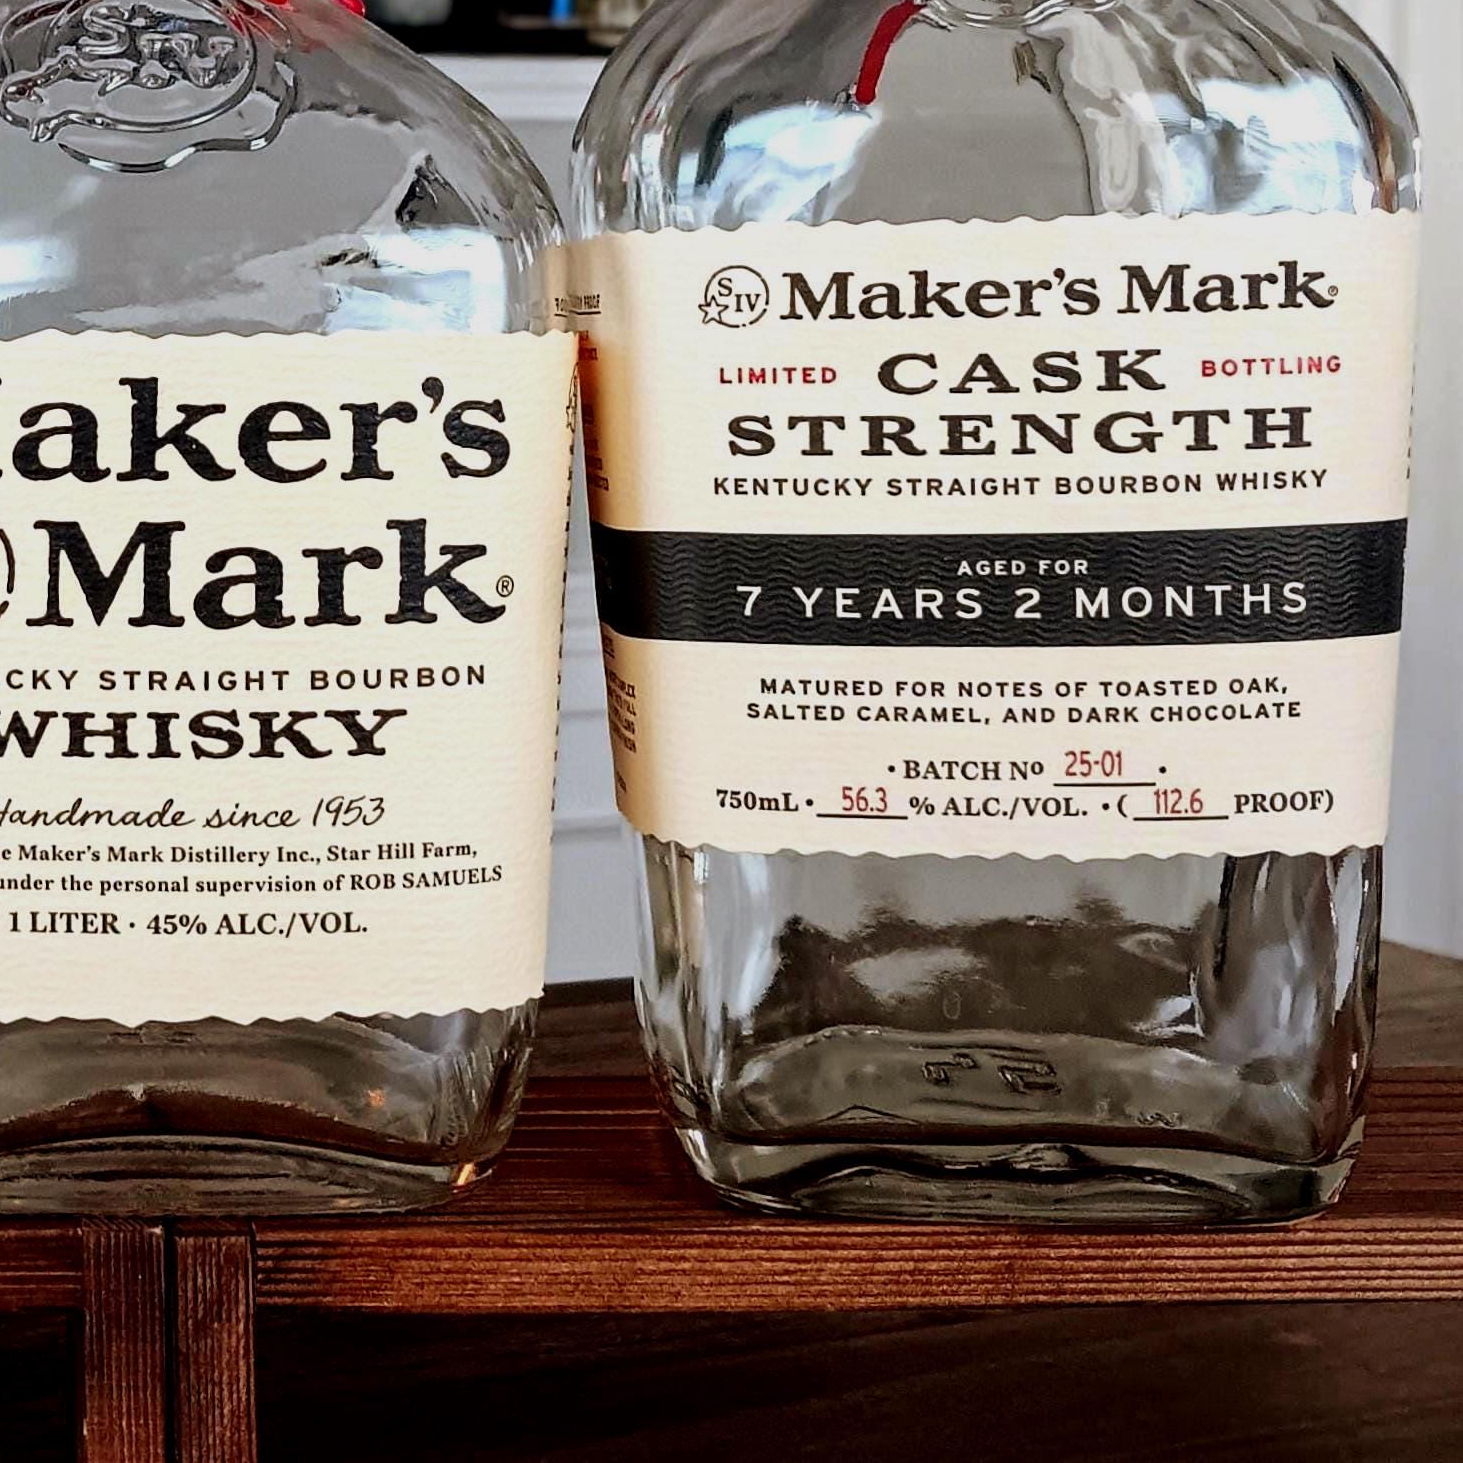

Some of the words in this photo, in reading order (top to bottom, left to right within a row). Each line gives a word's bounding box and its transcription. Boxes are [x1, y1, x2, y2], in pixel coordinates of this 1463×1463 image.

[779, 267, 1101, 321] Maker's
[719, 366, 837, 385] LIMITED
[877, 348, 1167, 396] CASK
[1201, 355, 1341, 378] BOTTLING
[727, 406, 1312, 457] STRENGTH
[713, 476, 873, 497] KENTUCKY
[886, 477, 1041, 497] STRAIGHT
[1055, 473, 1202, 495] BOURBON
[1216, 468, 1328, 492] WHISKY
[957, 560, 1026, 576] AGED
[1038, 559, 1088, 575] FOR
[736, 585, 762, 616] 7
[792, 586, 982, 619] YEARS
[1014, 588, 1042, 619] 2
[1075, 581, 1307, 619] MONTHS
[99, 669, 290, 692] STRAIGHT
[310, 664, 485, 691] BOURBON
[760, 677, 884, 697] MATURED
[895, 681, 945, 698] FOR
[957, 681, 1043, 698] NOTES
[1054, 681, 1088, 698] OF
[1098, 679, 1218, 698] TOASTED
[1228, 676, 1288, 695] OAK,
[746, 702, 846, 722] SALTED
[856, 705, 991, 726] CARAMEL,
[1001, 707, 1056, 724] AND
[1067, 706, 1139, 724] DARK
[1150, 701, 1301, 723] CHOCOLATE
[902, 759, 1002, 781] BATCH
[1064, 750, 1122, 778] 25-01
[203, 799, 301, 829] since
[313, 795, 385, 827] 1953
[715, 788, 799, 813] 750mL
[841, 786, 888, 813] 56.3
[942, 796, 1087, 820] ALC./VOL.
[1153, 789, 1203, 814] 112.6
[1233, 788, 1334, 815] PROOF)
[17, 844, 101, 863] Maker's
[107, 845, 164, 863] Mark
[170, 845, 270, 868] Distillery
[277, 846, 321, 865] Inc.,
[326, 845, 371, 862] Star
[377, 841, 415, 861] Hill
[421, 841, 478, 859] Farm,
[60, 874, 93, 892] the
[99, 875, 189, 897] personal
[195, 874, 317, 898] supervision
[322, 873, 346, 892] of
[349, 873, 396, 891] ROB
[402, 864, 503, 889] SAMUELS
[9, 911, 21, 933] 1
[29, 910, 122, 935] LITER
[146, 913, 208, 936] 45%
[214, 911, 368, 939] ALC./VOL.
